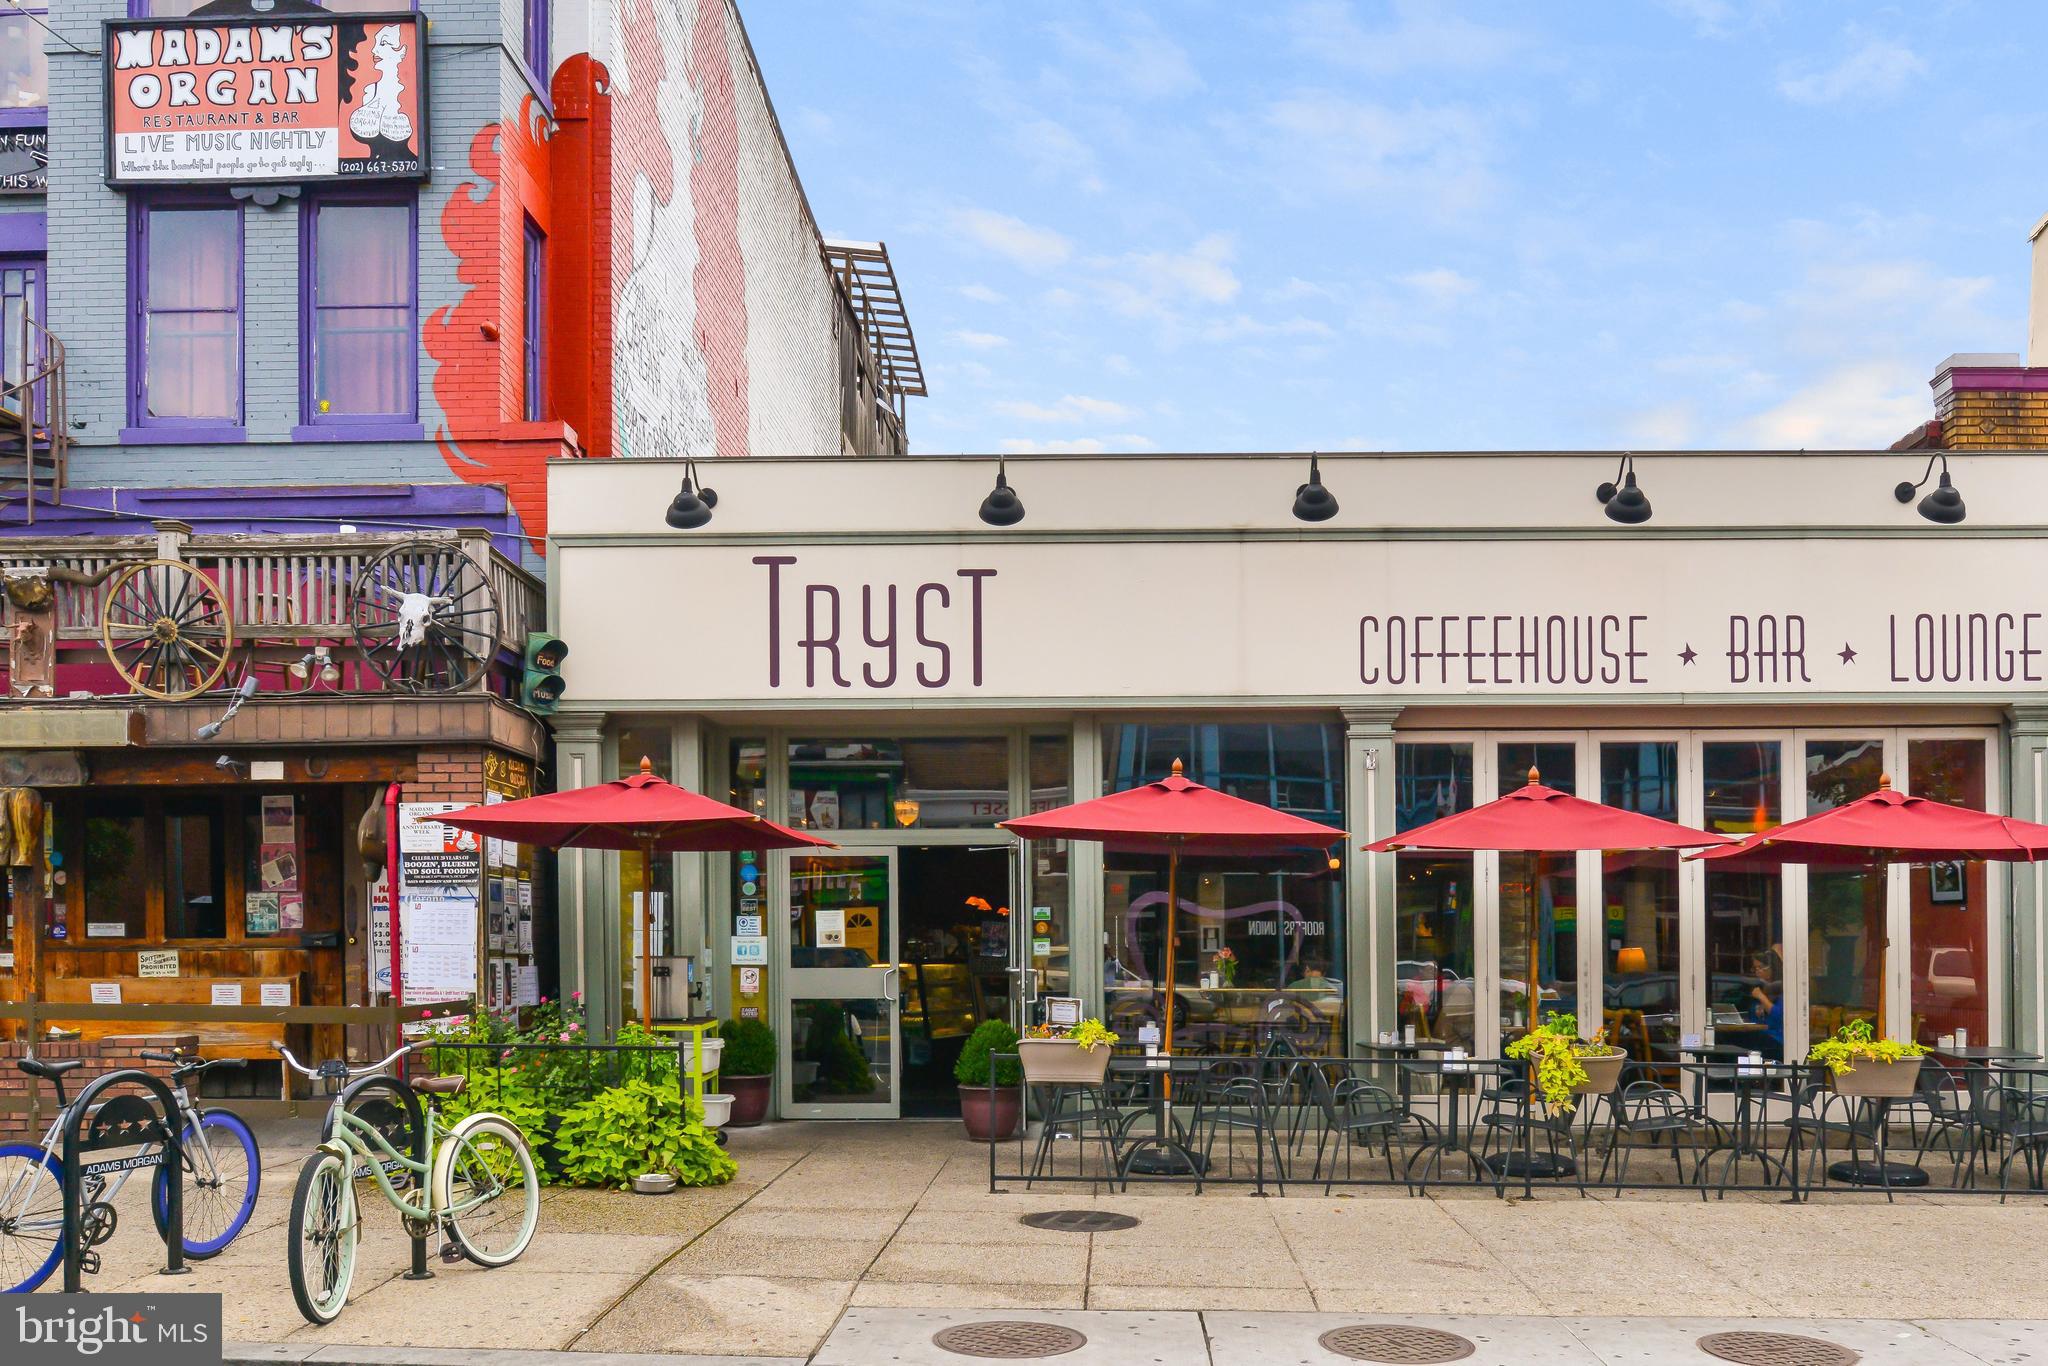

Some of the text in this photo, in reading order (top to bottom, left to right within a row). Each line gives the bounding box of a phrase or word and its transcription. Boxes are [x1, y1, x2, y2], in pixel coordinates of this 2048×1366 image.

[115, 26, 333, 70] MADAM'S
[128, 67, 319, 109] ORGAN
[143, 111, 300, 128] RESTAURANT & BAR
[15, 134, 46, 146] FUN
[124, 130, 326, 154] LIVE MUSIC NIGHTLY
[121, 160, 151, 172] Where
[152, 159, 169, 171] the
[171, 158, 214, 173] beautiful
[216, 157, 245, 174] people
[246, 161, 257, 173] go
[258, 156, 270, 168] to
[271, 155, 287, 173] get
[340, 160, 418, 173] (202) 667-5370
[0, 174, 28, 188] HIS
[752, 556, 998, 689] TRYST
[1360, 613, 2042, 685] COFFEEHOUSE BAR LOUNGE
[86, 1154, 163, 1175] ADAMS MORGAN
